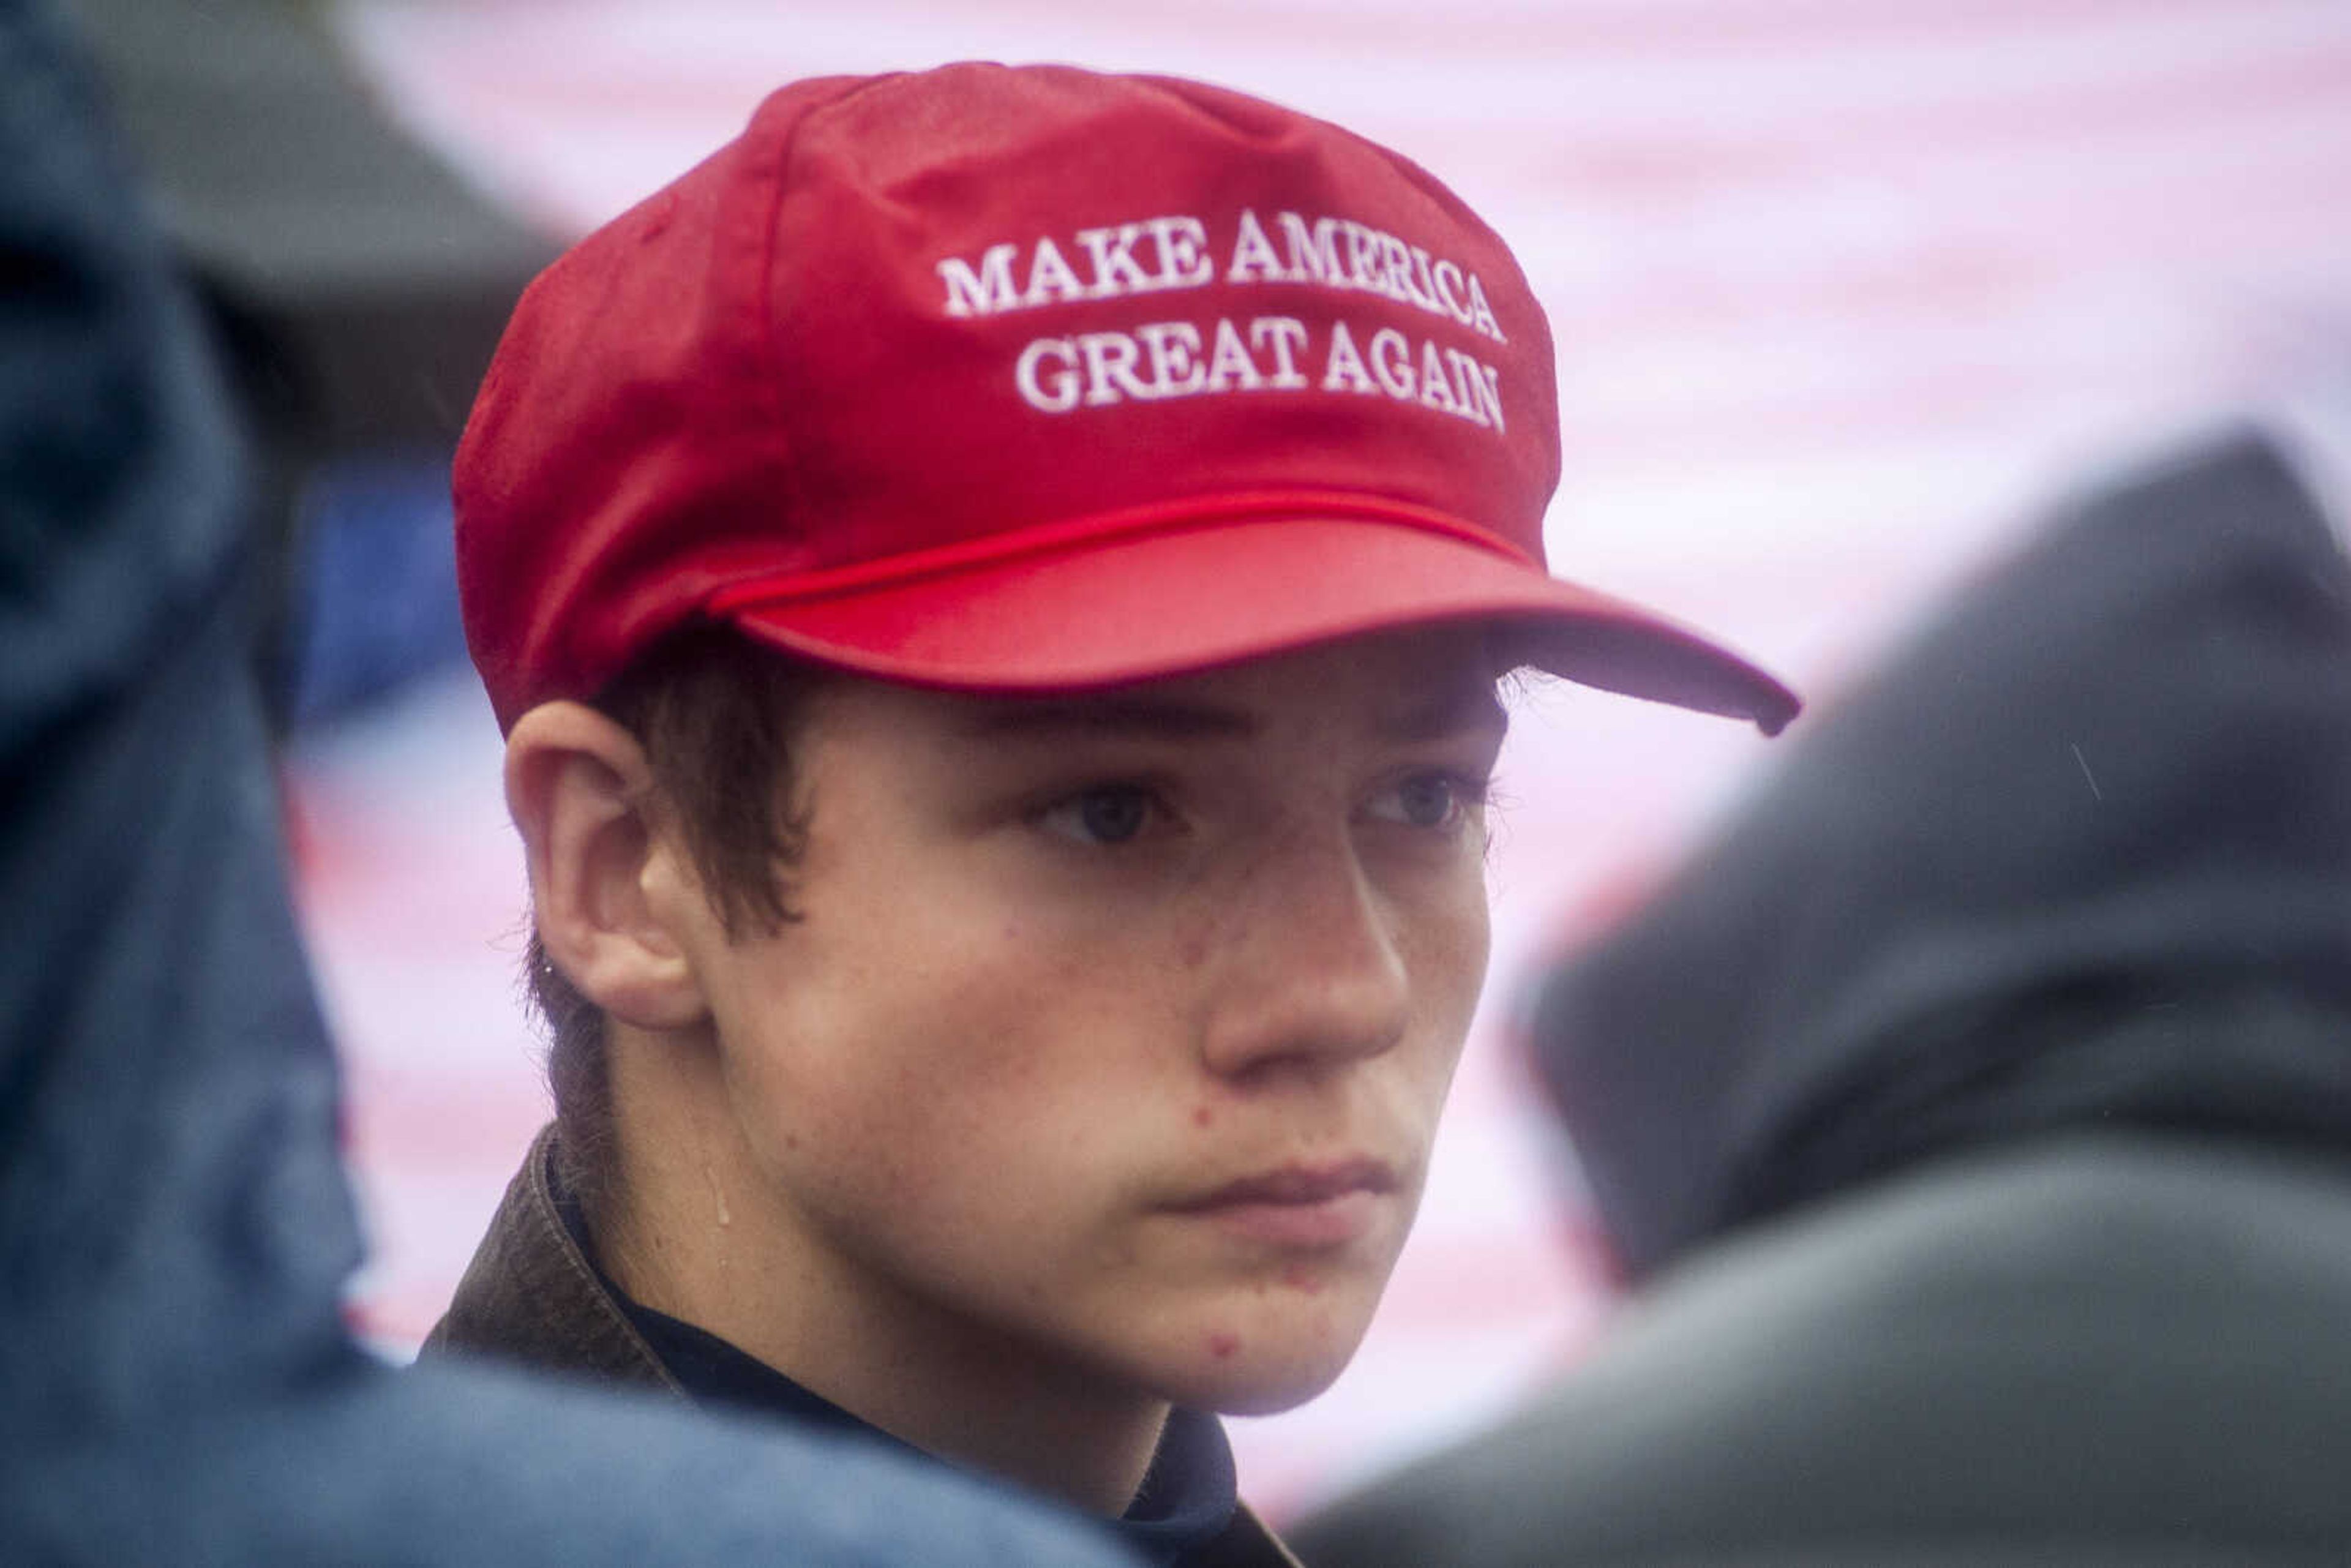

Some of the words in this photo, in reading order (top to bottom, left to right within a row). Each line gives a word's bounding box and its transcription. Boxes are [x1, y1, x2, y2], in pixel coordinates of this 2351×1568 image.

[936, 216, 1213, 318] MAKE
[1227, 209, 1509, 345] AMERICA
[1014, 316, 1308, 413] GREAT
[1322, 321, 1506, 435] AGAIN
